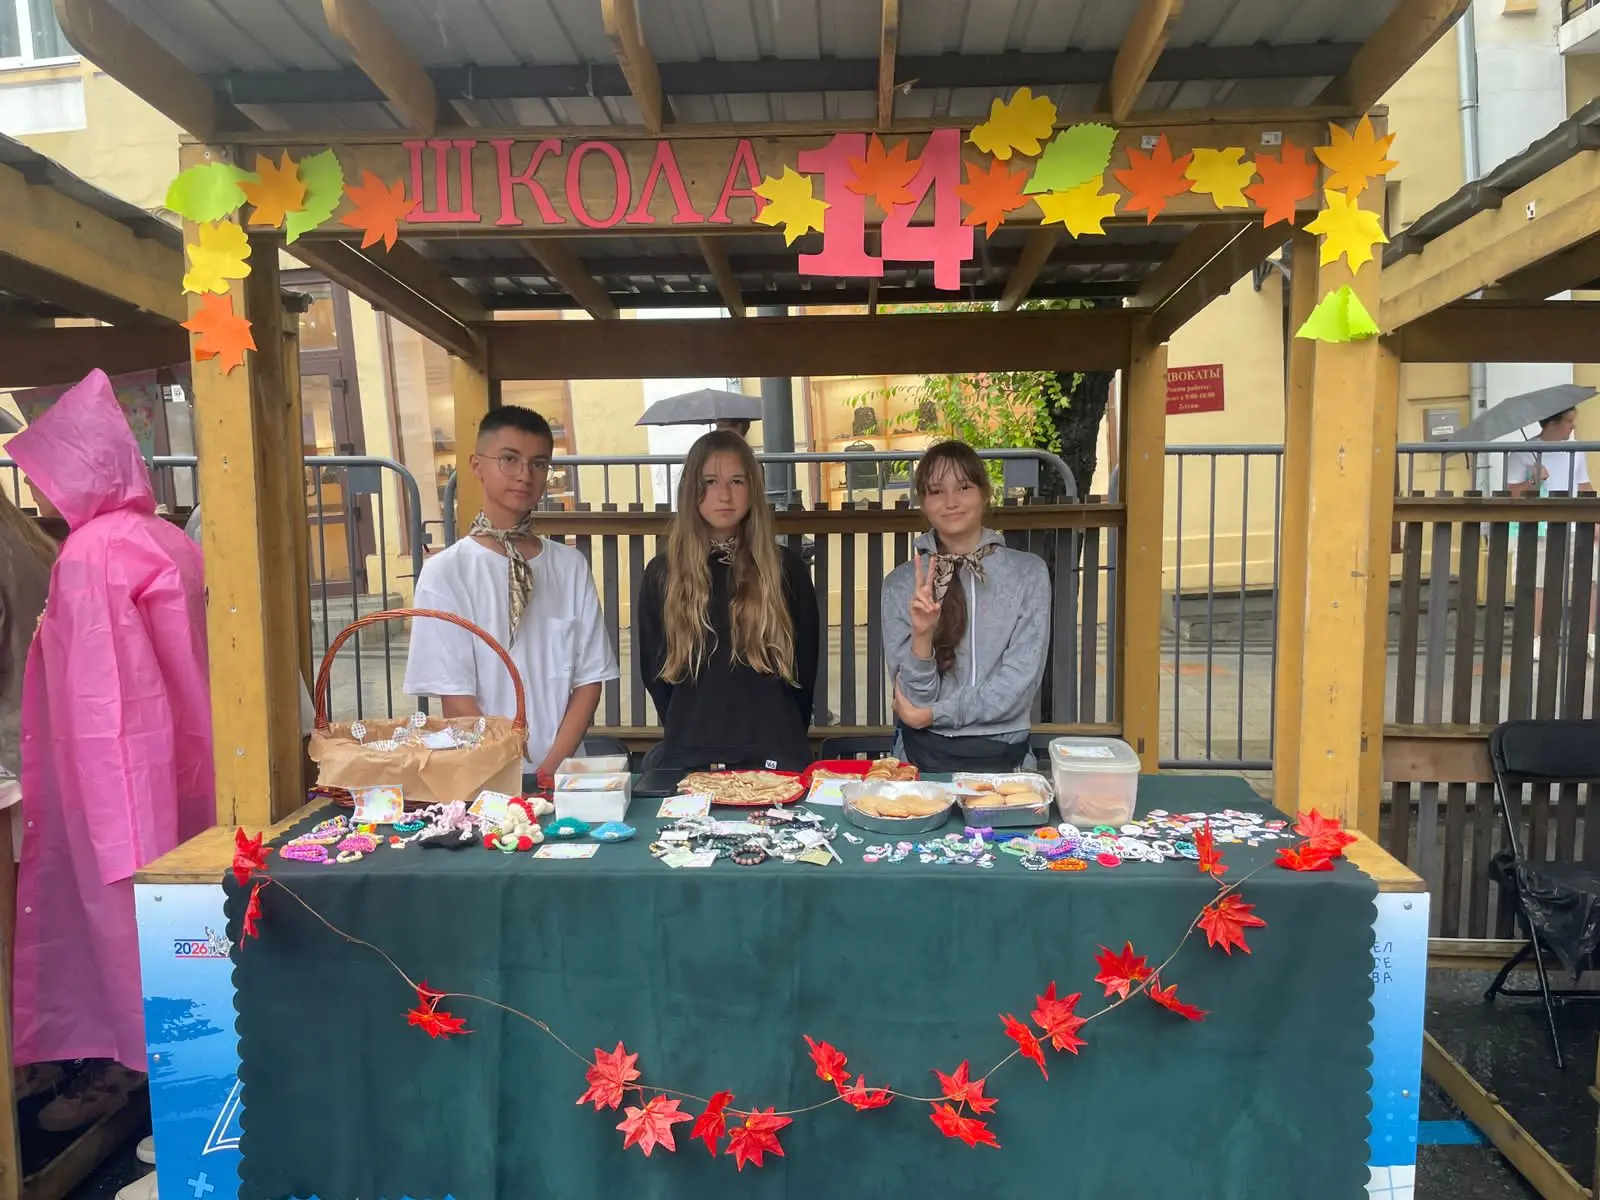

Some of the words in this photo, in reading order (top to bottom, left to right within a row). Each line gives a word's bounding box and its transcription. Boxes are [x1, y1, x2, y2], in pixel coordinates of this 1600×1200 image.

[402, 138, 772, 229] ШКОЛА
[798, 129, 974, 291] 14
[174, 942, 208, 955] 2026
[1373, 941, 1393, 953] ЕЛ
[1374, 957, 1392, 969] СЕ
[1372, 971, 1393, 984] ВА
